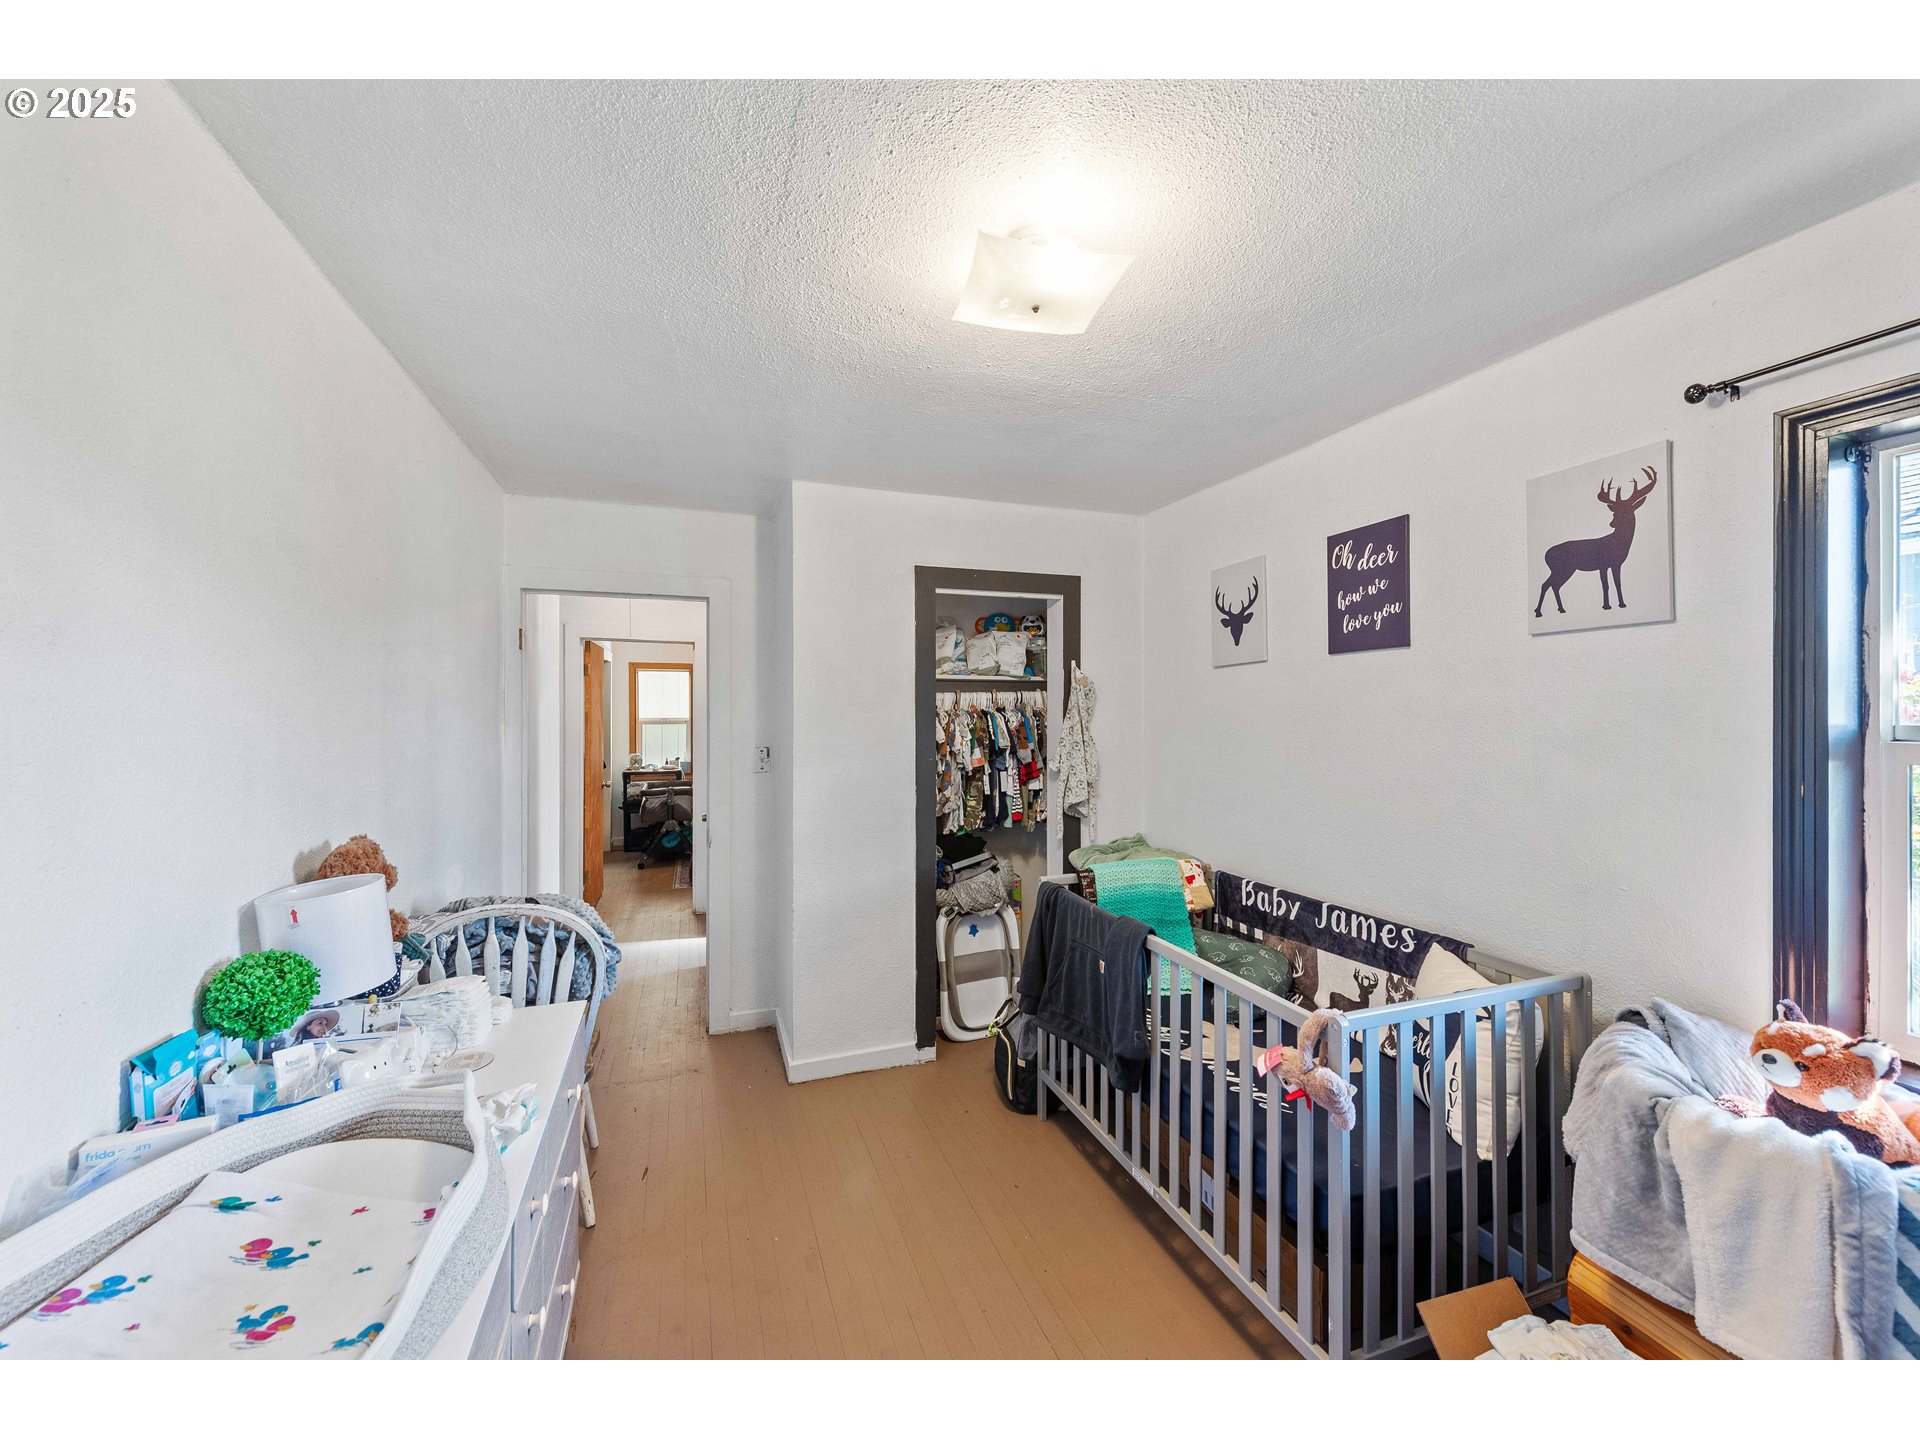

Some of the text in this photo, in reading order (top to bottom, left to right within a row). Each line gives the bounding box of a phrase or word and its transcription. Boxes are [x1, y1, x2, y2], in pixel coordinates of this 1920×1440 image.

[1331, 539, 1399, 571] Oh deer
[1337, 578, 1390, 611] how we
[1343, 601, 1403, 634] love you
[1241, 878, 1417, 953] Baby James
